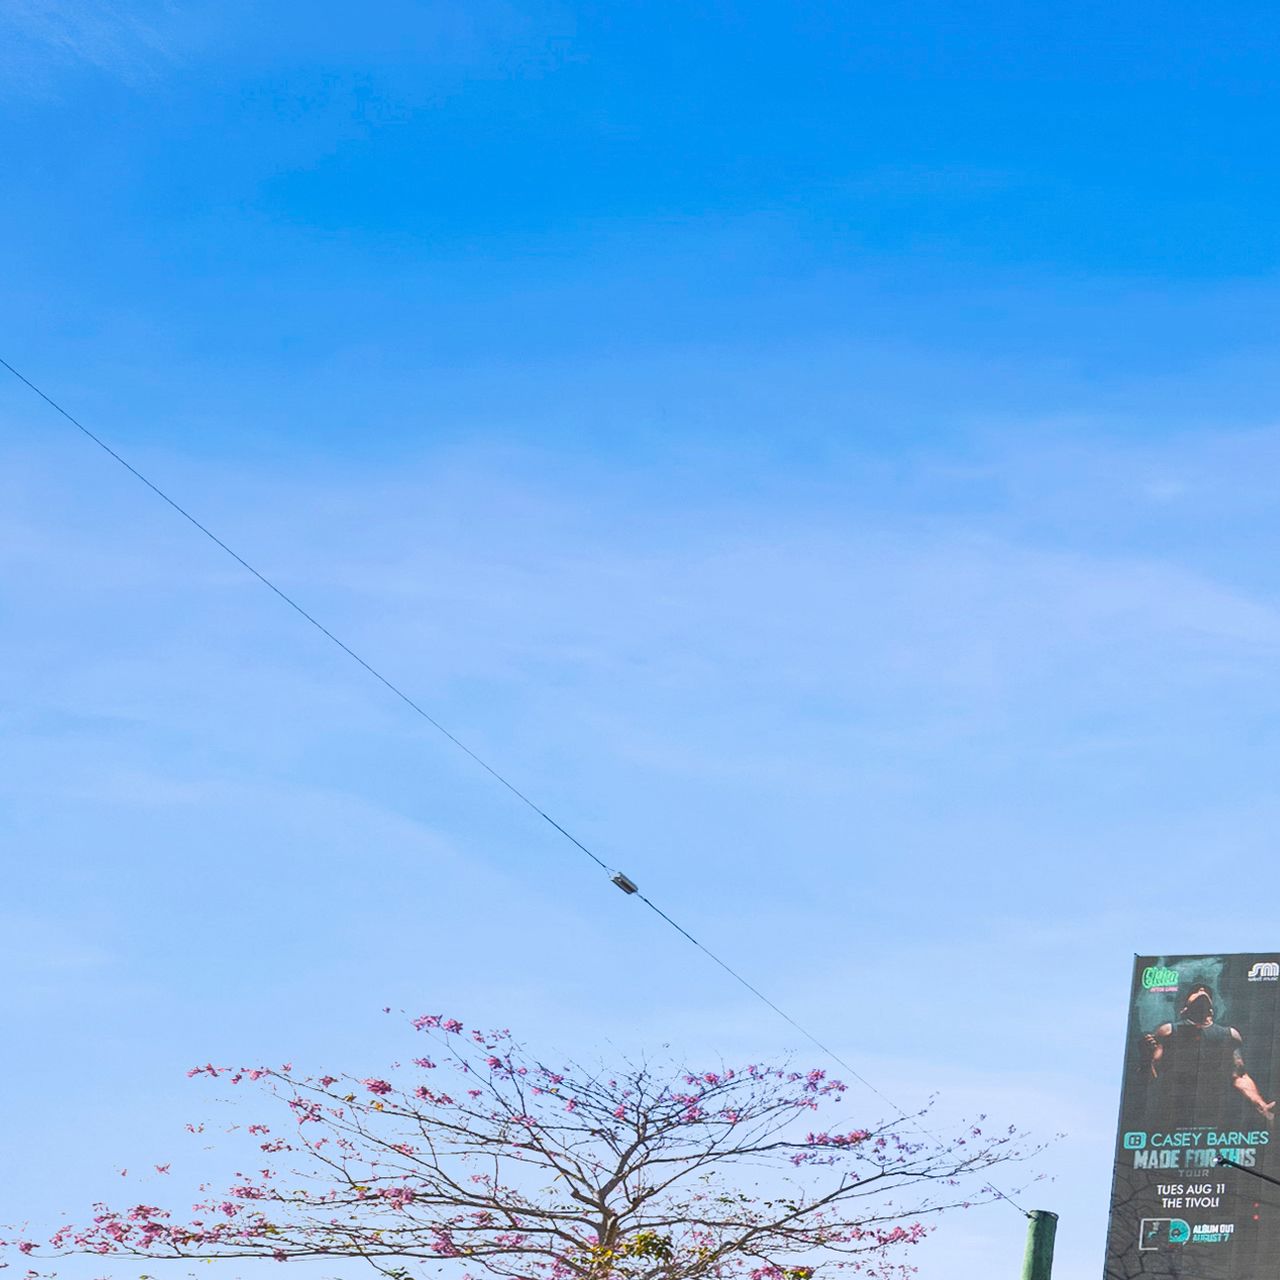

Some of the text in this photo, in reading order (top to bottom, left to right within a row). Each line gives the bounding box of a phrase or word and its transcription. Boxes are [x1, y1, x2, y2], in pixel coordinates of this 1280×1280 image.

[1151, 1132, 1202, 1147] CASEY
[1207, 1131, 1269, 1146] BARNES
[1134, 1148, 1256, 1169] MADE FOR THIS
[1178, 1169, 1210, 1177] TOUR
[1157, 1183, 1225, 1195] TUES AUG 11
[1162, 1197, 1219, 1209] THE TIVOLI
[1192, 1224, 1234, 1234] ALBUM OUT
